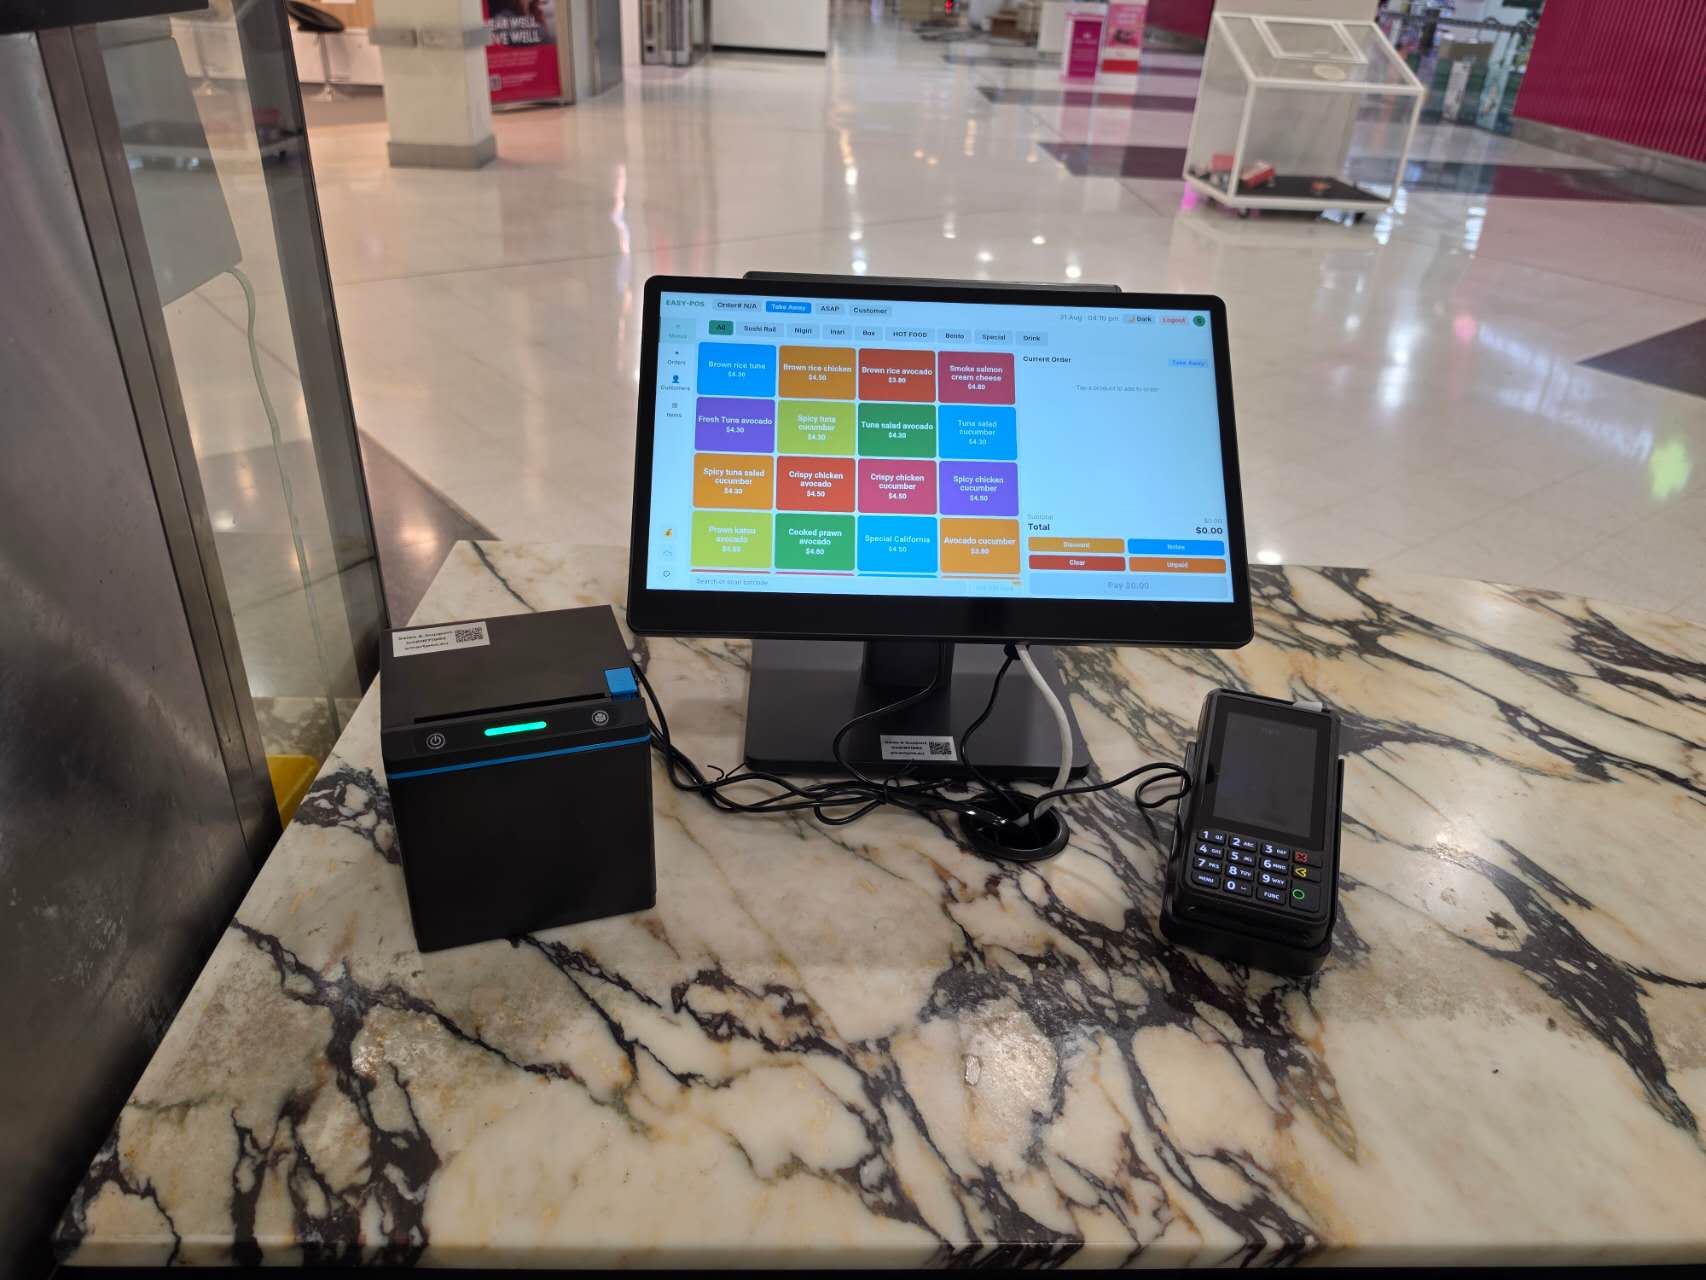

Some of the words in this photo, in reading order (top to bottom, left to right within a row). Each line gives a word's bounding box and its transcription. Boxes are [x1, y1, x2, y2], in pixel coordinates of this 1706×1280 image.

[698, 416, 720, 424] Fresh
[798, 415, 818, 424] Spicy
[704, 468, 724, 476] Spicy
[788, 470, 812, 480] Crispy
[870, 473, 894, 482] Crispy
[896, 474, 924, 482] chicken
[953, 475, 974, 484] Spicy
[975, 476, 1004, 484] chicken
[788, 528, 817, 536] Cooked
[818, 530, 842, 538] prawn
[1196, 526, 1223, 534] $0.00
[865, 535, 892, 544] Special
[894, 536, 931, 544] California
[944, 536, 976, 544] Avocado
[978, 537, 1016, 545] cucumber
[1108, 582, 1124, 590] Pay
[1203, 830, 1209, 839] 1
[1232, 838, 1240, 846] 2
[1200, 844, 1208, 853] 4
[1264, 845, 1273, 854] 3
[1231, 852, 1239, 860] 5
[1198, 858, 1206, 867] 7
[1264, 860, 1272, 868] 6
[1228, 866, 1238, 876] 8
[1198, 875, 1214, 884] MENU
[1262, 874, 1270, 884] 9
[1227, 881, 1236, 890] 0
[1264, 892, 1280, 900] FUNC
